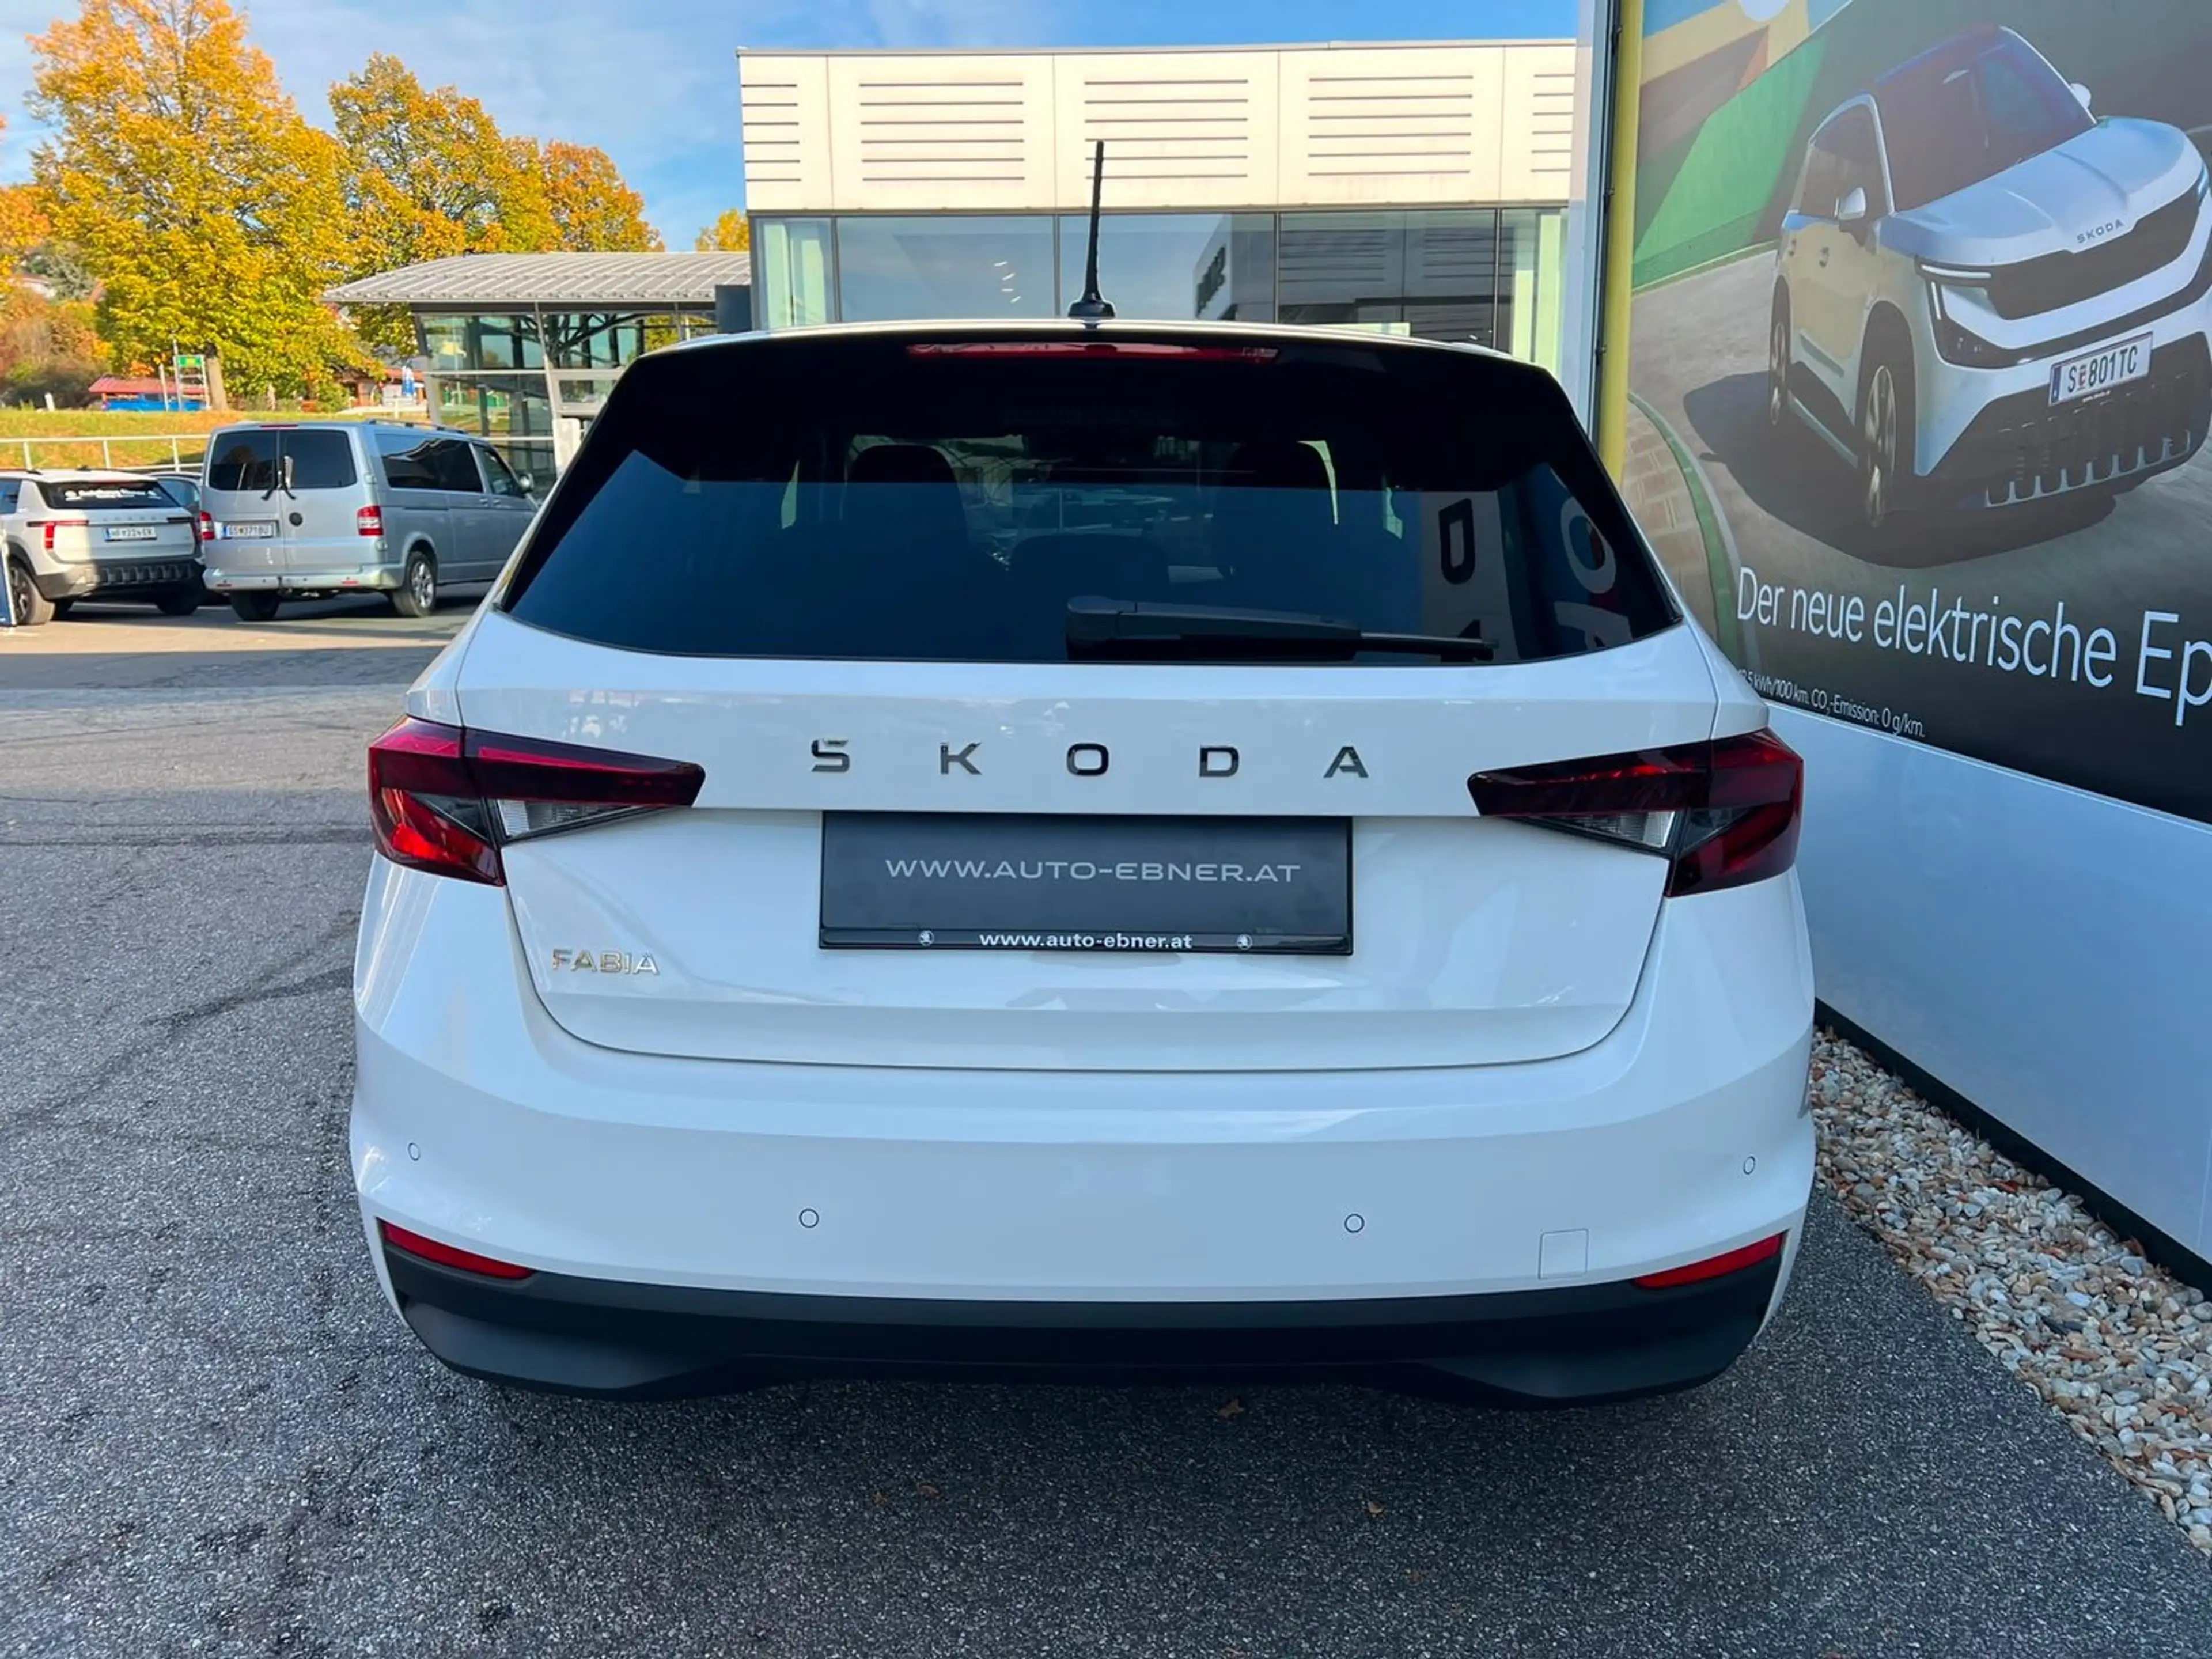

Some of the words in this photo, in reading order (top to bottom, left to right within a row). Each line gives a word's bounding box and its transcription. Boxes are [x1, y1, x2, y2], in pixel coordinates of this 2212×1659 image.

[2077, 218, 2125, 244] SKODA
[1737, 566, 1785, 626] Der
[1790, 587, 1865, 642] neue
[1873, 584, 2117, 688] elektrische
[1881, 707, 1891, 728] 0
[1892, 712, 1926, 738] g/km.
[885, 858, 1301, 883] WWW.AUTO-EBNER.AT
[979, 933, 1193, 950] www.auto-ebner.at
[552, 949, 660, 975] FABIA
